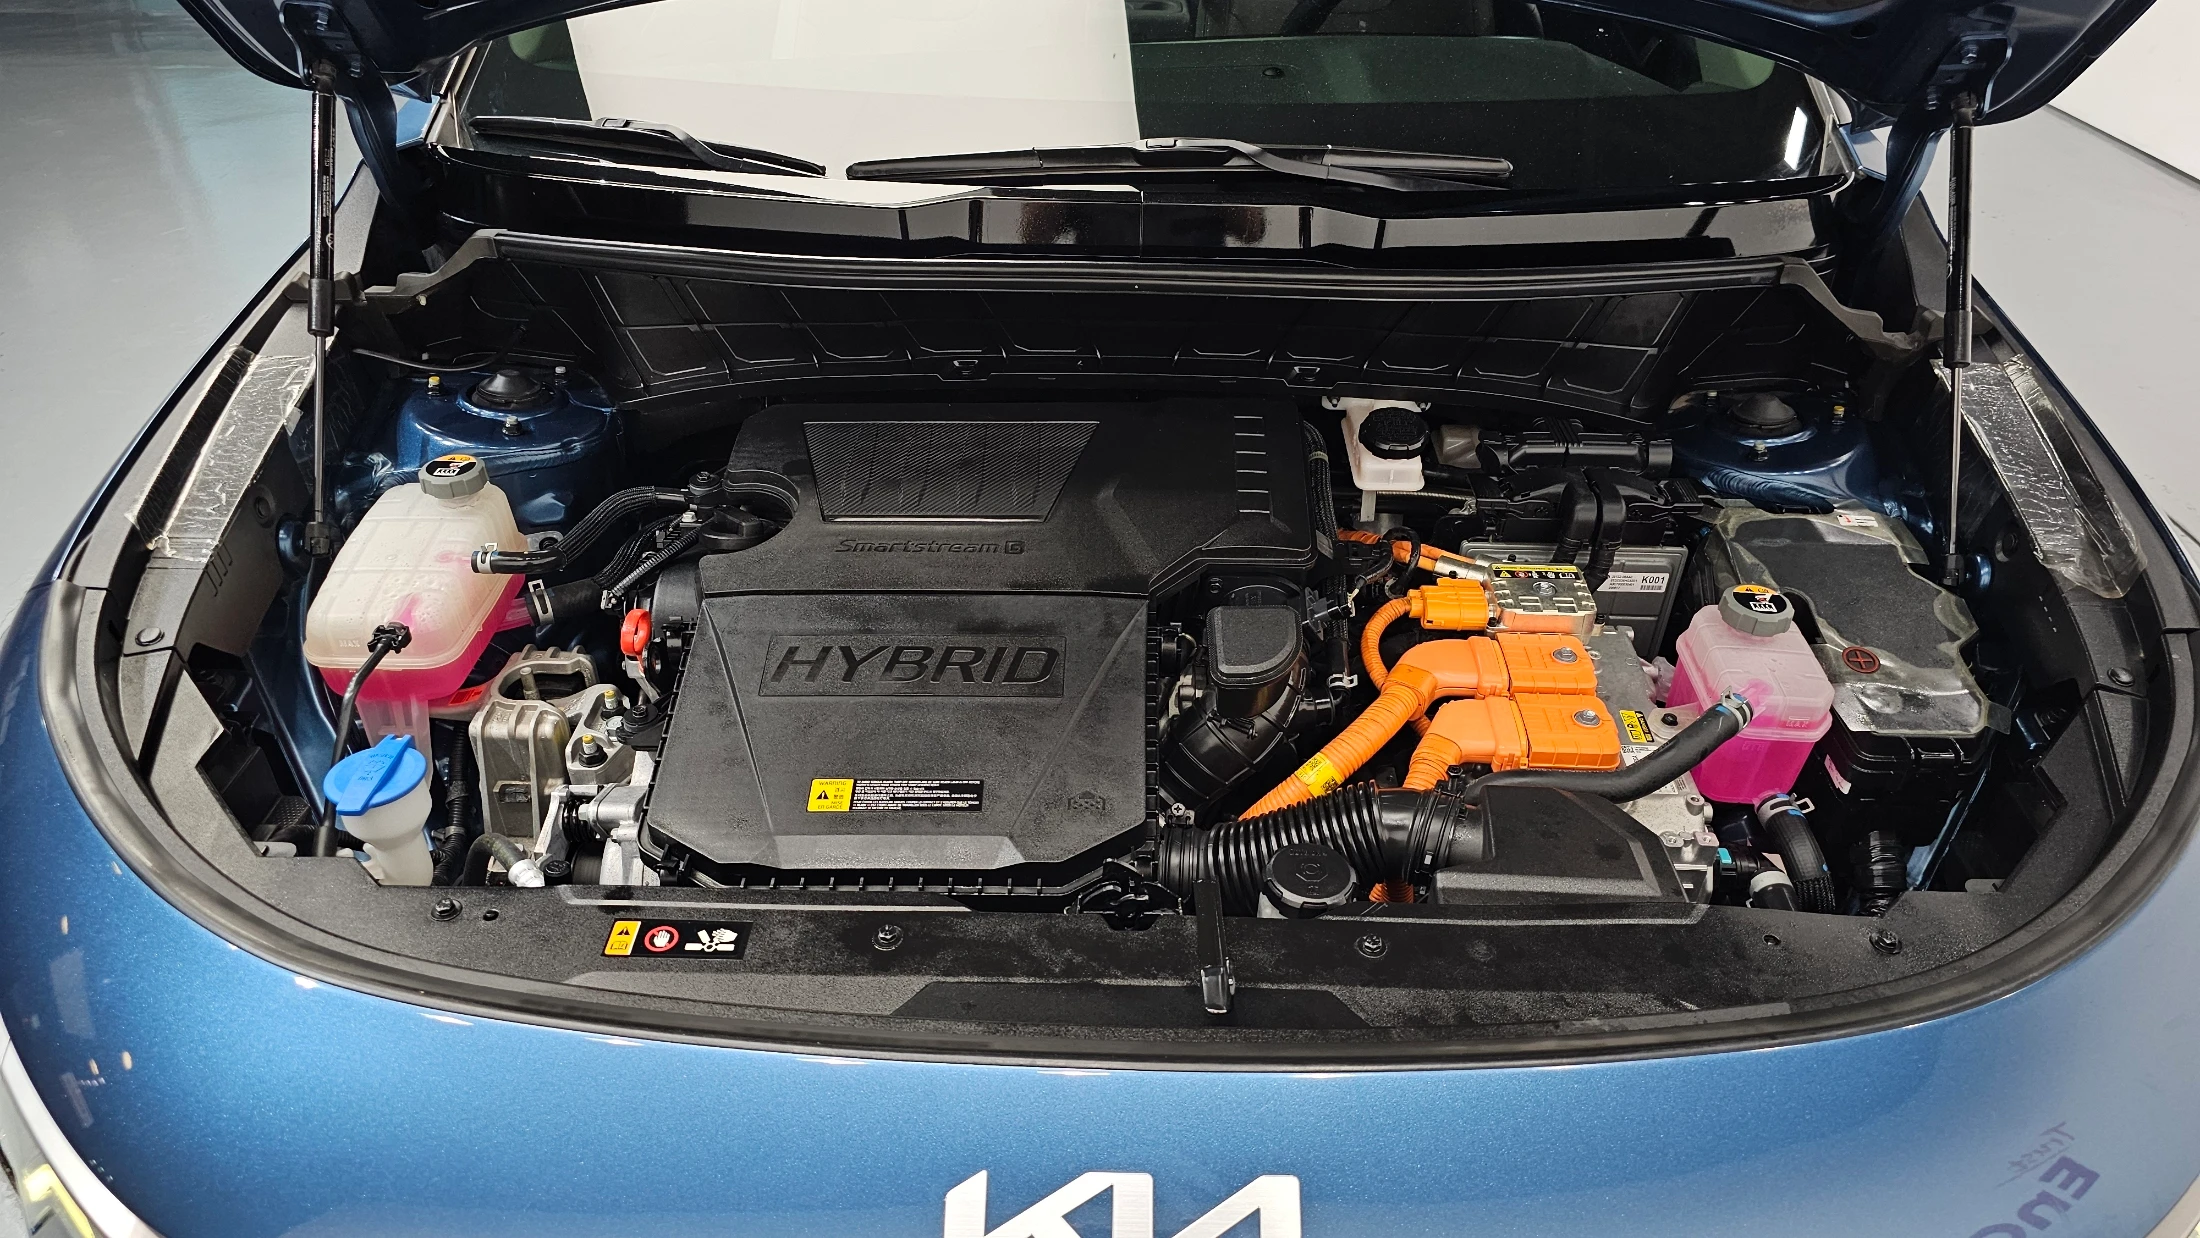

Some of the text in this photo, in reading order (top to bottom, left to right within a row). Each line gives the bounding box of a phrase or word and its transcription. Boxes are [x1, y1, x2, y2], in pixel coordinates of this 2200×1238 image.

[835, 539, 1001, 553] Smartstream
[1641, 576, 1665, 584] K001
[340, 639, 361, 648] MAX
[770, 645, 1060, 684] HYBRID
[1785, 719, 1809, 728] MAX
[943, 1169, 1302, 1238] KIA
